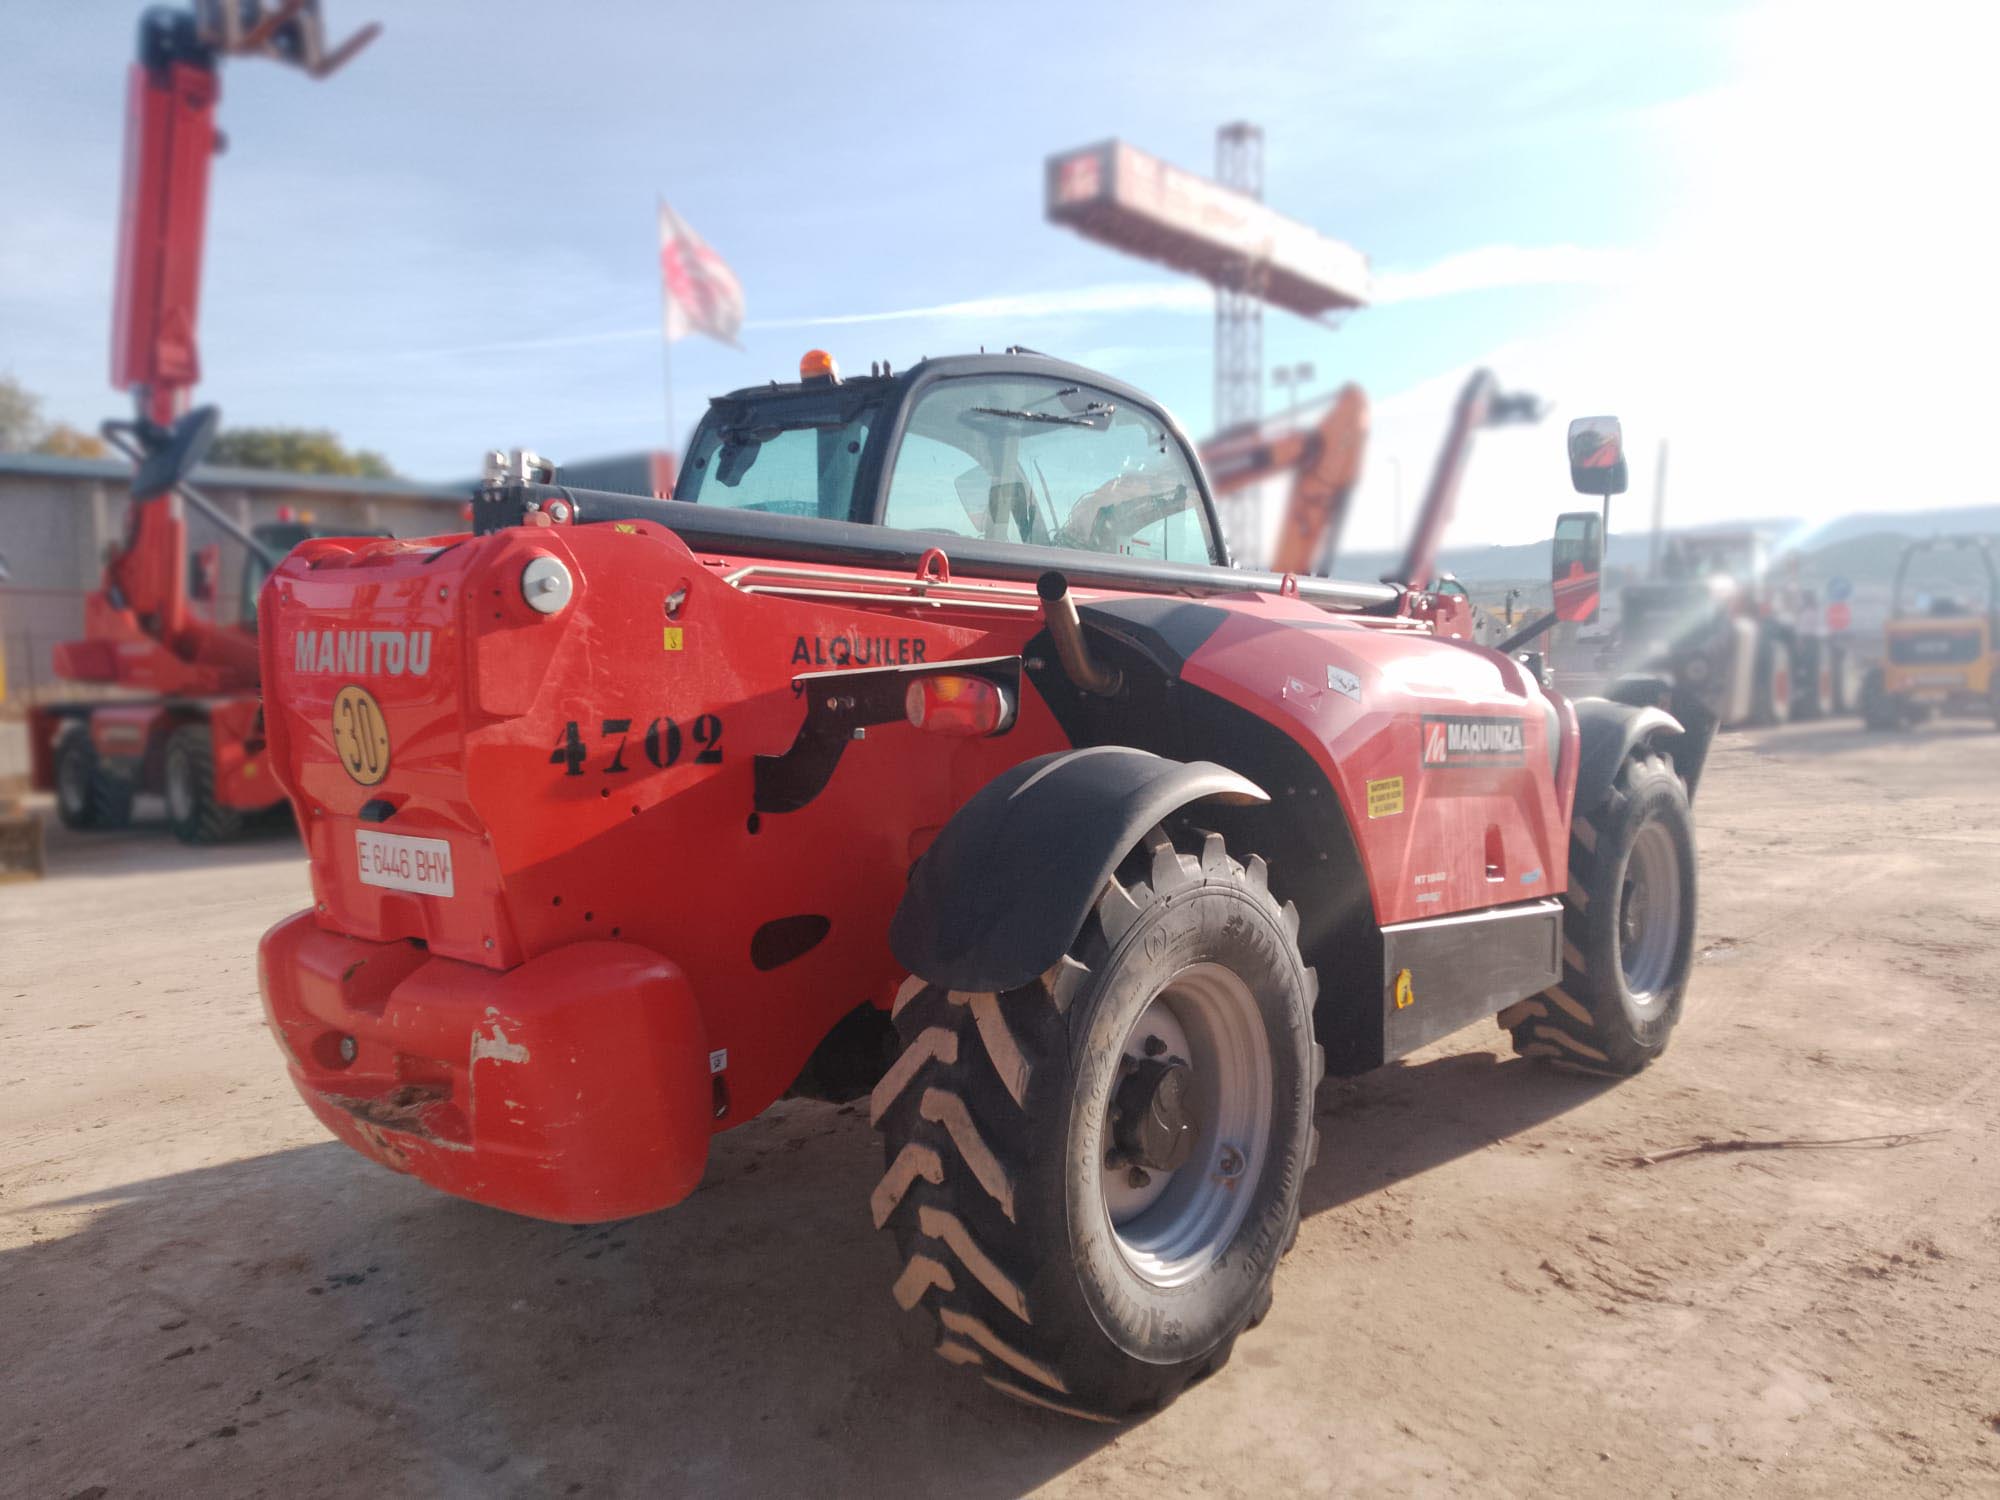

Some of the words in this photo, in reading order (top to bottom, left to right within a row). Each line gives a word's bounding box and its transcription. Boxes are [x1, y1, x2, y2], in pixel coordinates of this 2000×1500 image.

[294, 630, 432, 676] MANITOU
[791, 635, 926, 666] ALQUILER
[342, 698, 378, 773] 30
[549, 713, 723, 776] 4702
[1447, 723, 1522, 752] MAQUINZA
[359, 841, 369, 873] E
[373, 844, 410, 879] 6446
[416, 849, 447, 884] BHV
